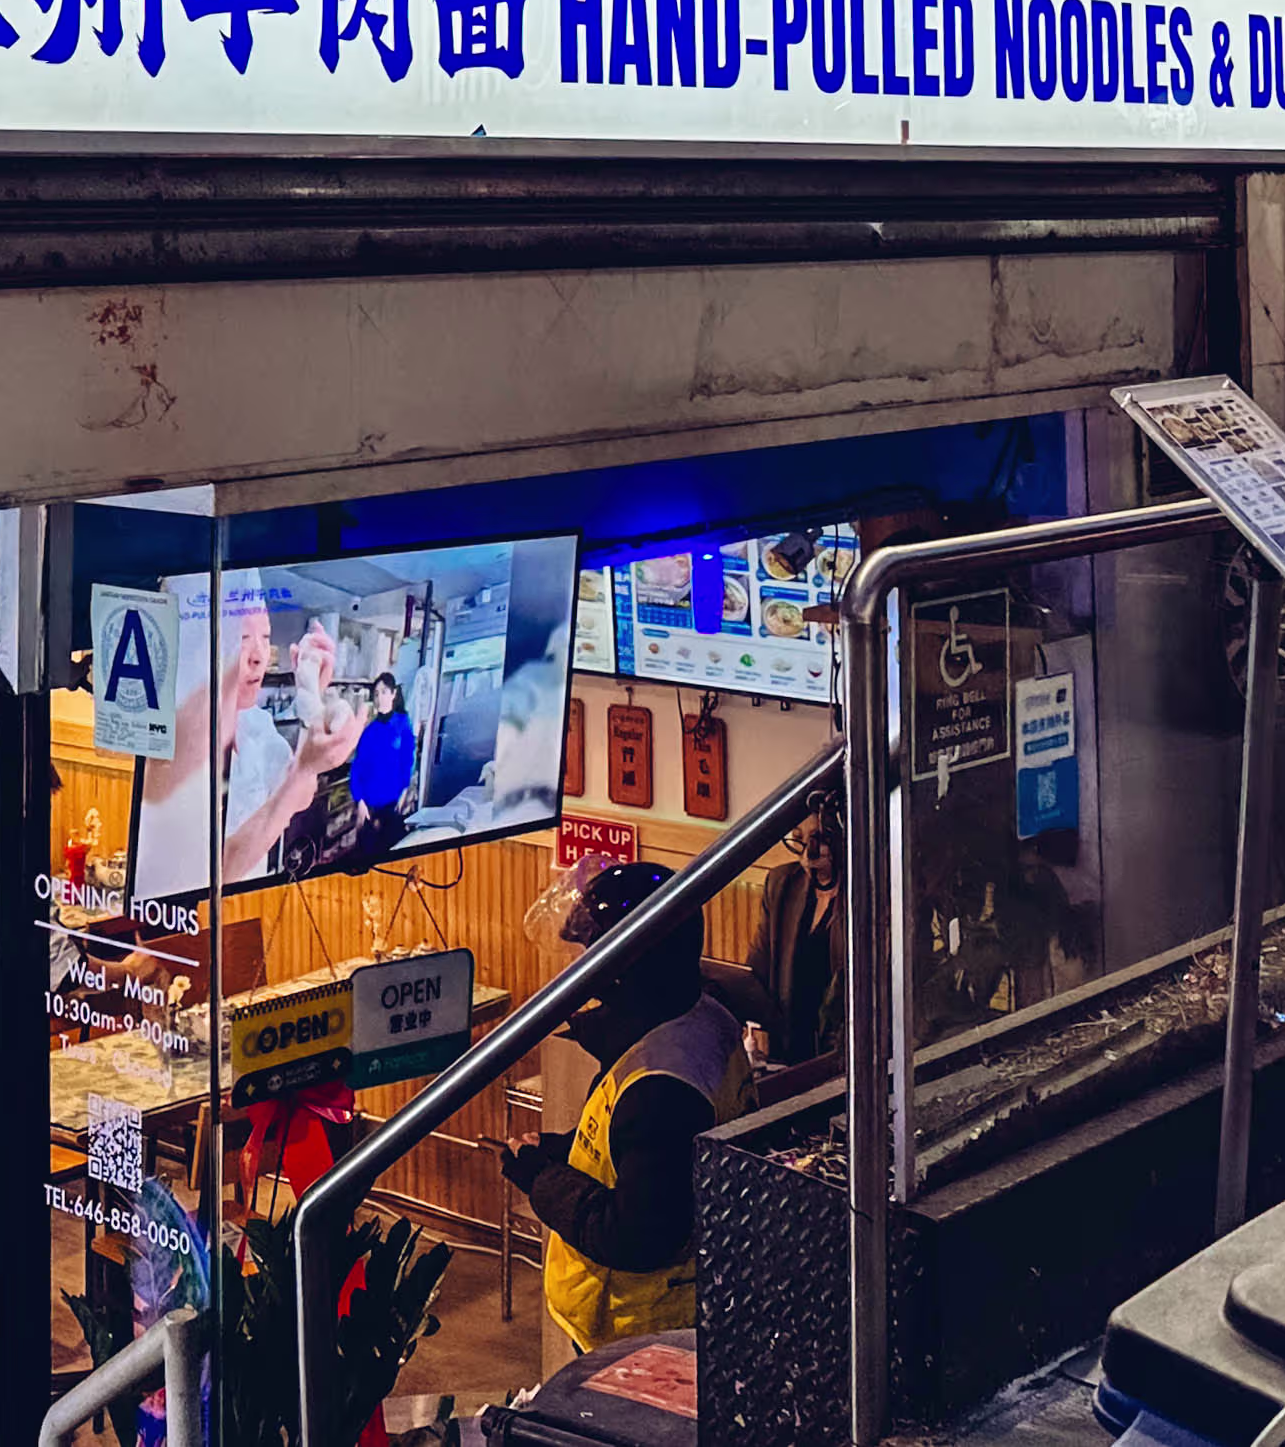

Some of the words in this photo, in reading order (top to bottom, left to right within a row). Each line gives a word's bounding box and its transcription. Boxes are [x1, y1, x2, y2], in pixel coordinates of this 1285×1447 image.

[1209, 21, 1234, 108] &
[104, 609, 160, 710] A
[148, 722, 167, 735] NYC
[932, 715, 992, 742] ASSISTANCE
[562, 820, 603, 842] PICK
[609, 828, 631, 846] UP
[35, 873, 123, 917] OPENING
[130, 896, 200, 937] HOURS
[68, 959, 106, 991] Wed
[124, 974, 164, 1006] Mon
[381, 975, 442, 1010] OPEN
[44, 991, 189, 1053] 10:30am-9:00pm
[257, 1010, 329, 1054] OPEN
[44, 1184, 190, 1256] TEL:646-858-0050
